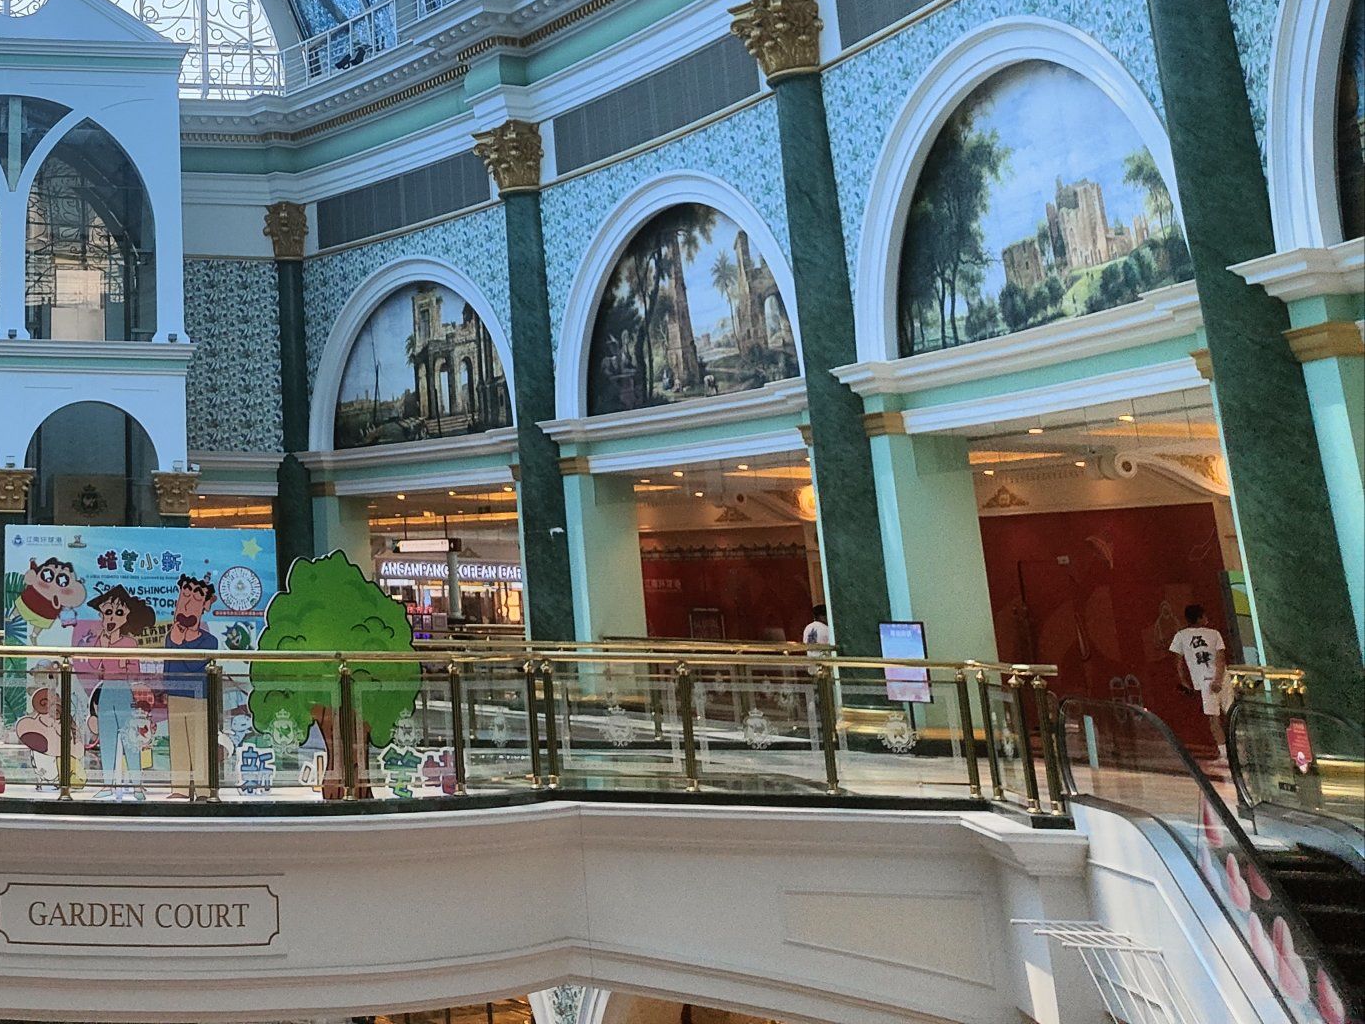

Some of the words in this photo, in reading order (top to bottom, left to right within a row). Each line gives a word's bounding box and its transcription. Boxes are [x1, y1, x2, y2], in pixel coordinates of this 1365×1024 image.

[97, 549, 183, 573] 蜡笔小新
[137, 585, 180, 596] SHINCHA
[28, 901, 145, 927] GARDEN
[154, 903, 250, 928] COURT
